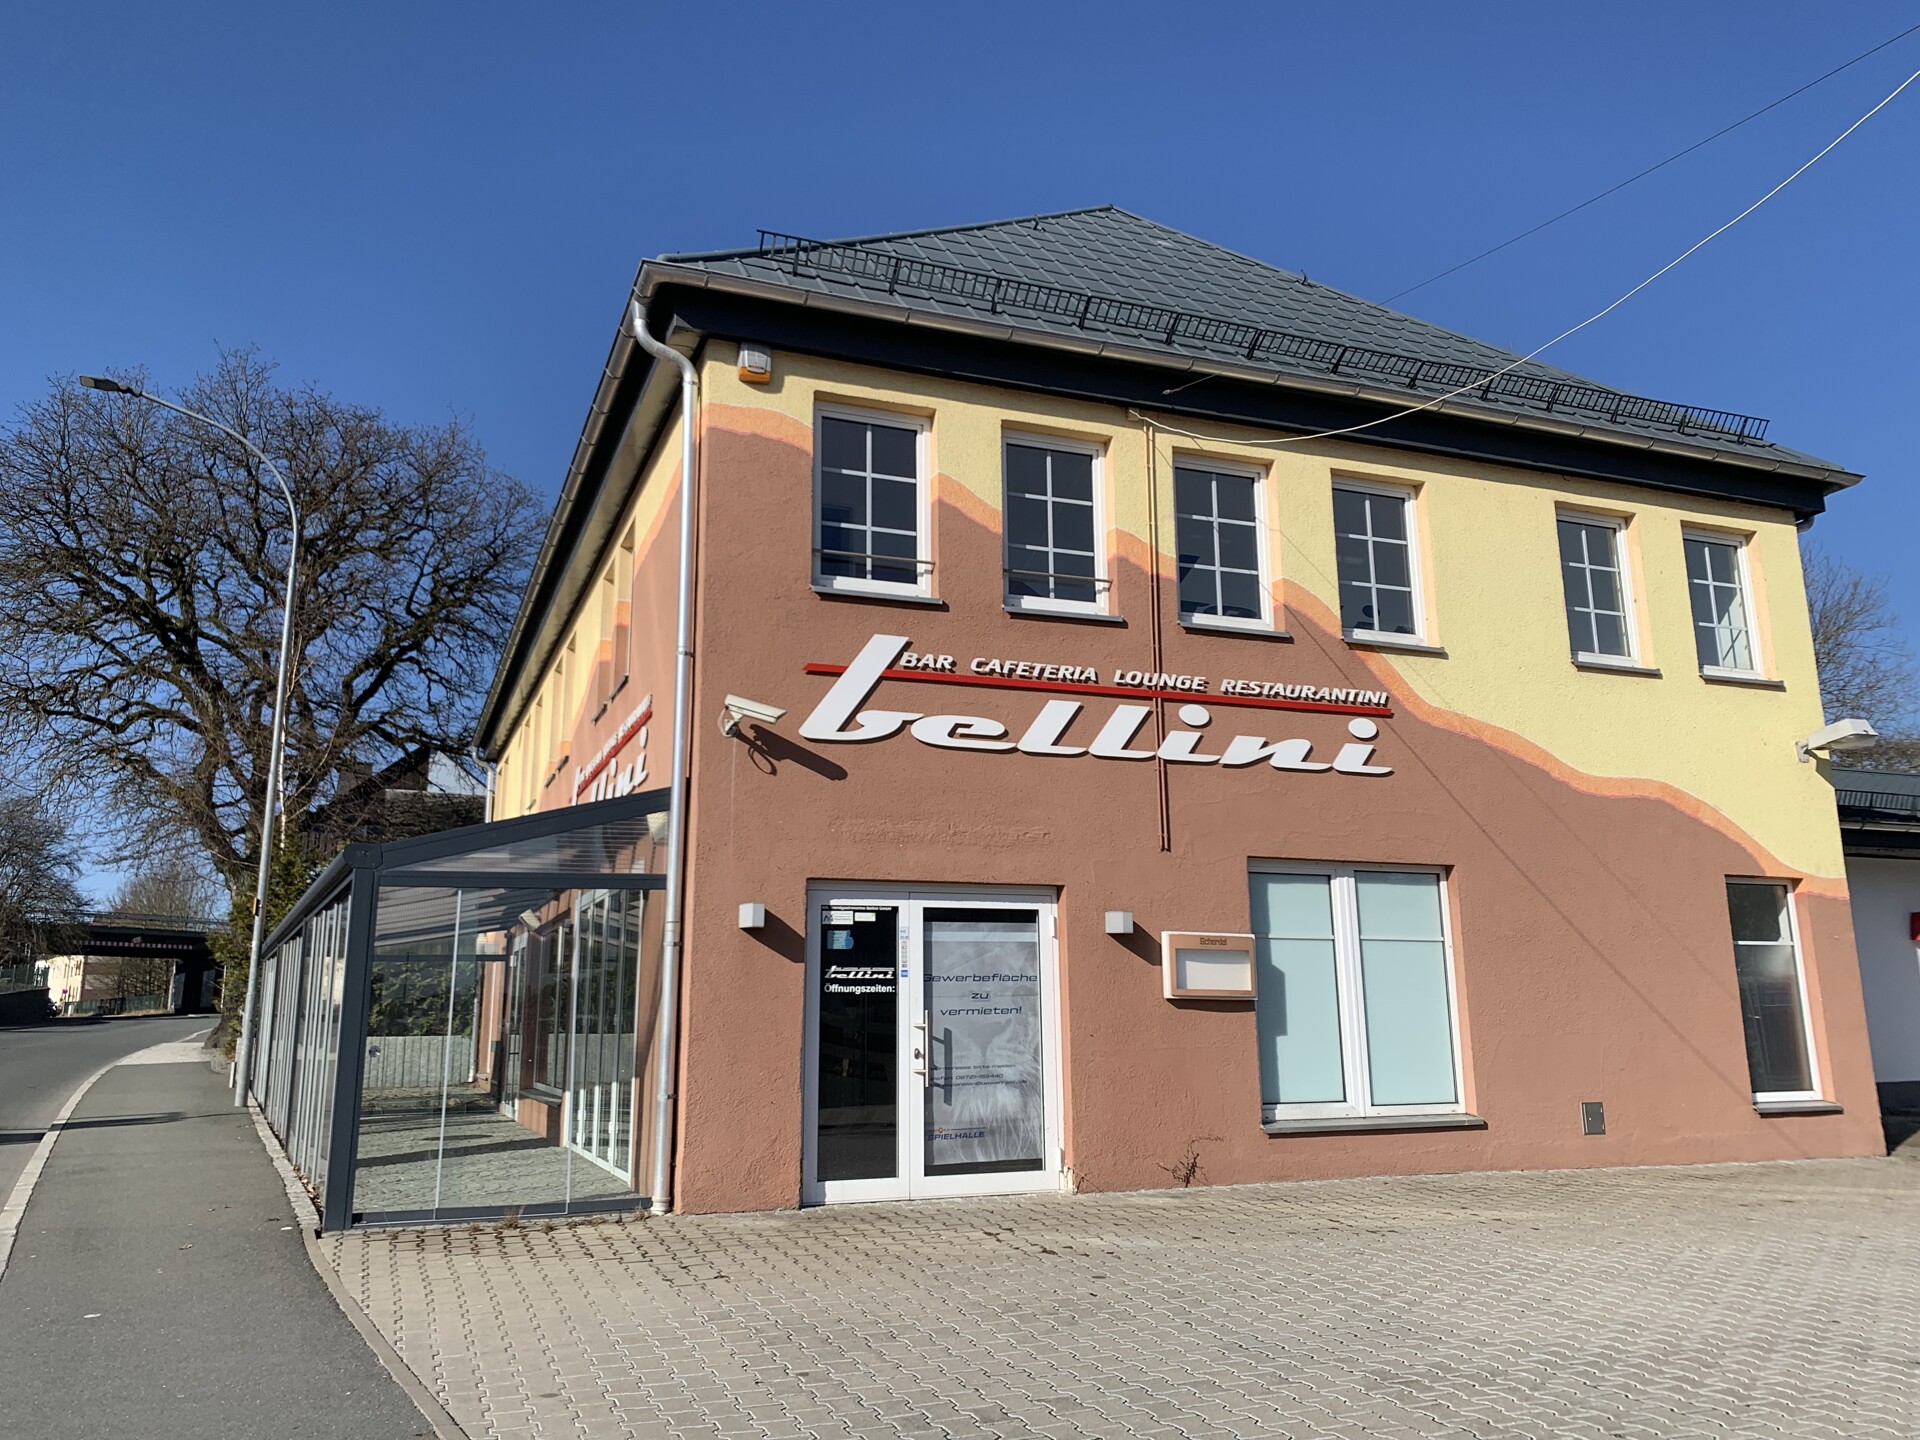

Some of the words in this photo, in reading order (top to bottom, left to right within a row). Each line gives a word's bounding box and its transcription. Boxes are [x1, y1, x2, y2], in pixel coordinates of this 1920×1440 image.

[899, 651, 954, 670] BAR
[970, 657, 1097, 683] CAFETERIA
[1113, 669, 1207, 692] LOUNGE
[1220, 678, 1389, 706] RESTAURANTINI
[799, 634, 1393, 774] bellini
[924, 973, 1038, 982] Gewerbefläche
[824, 982, 896, 995] Öffnungszeiten:
[971, 992, 989, 1000] zu
[940, 1006, 1022, 1016] vermieten!
[927, 1131, 985, 1141] SPIELHALLE
